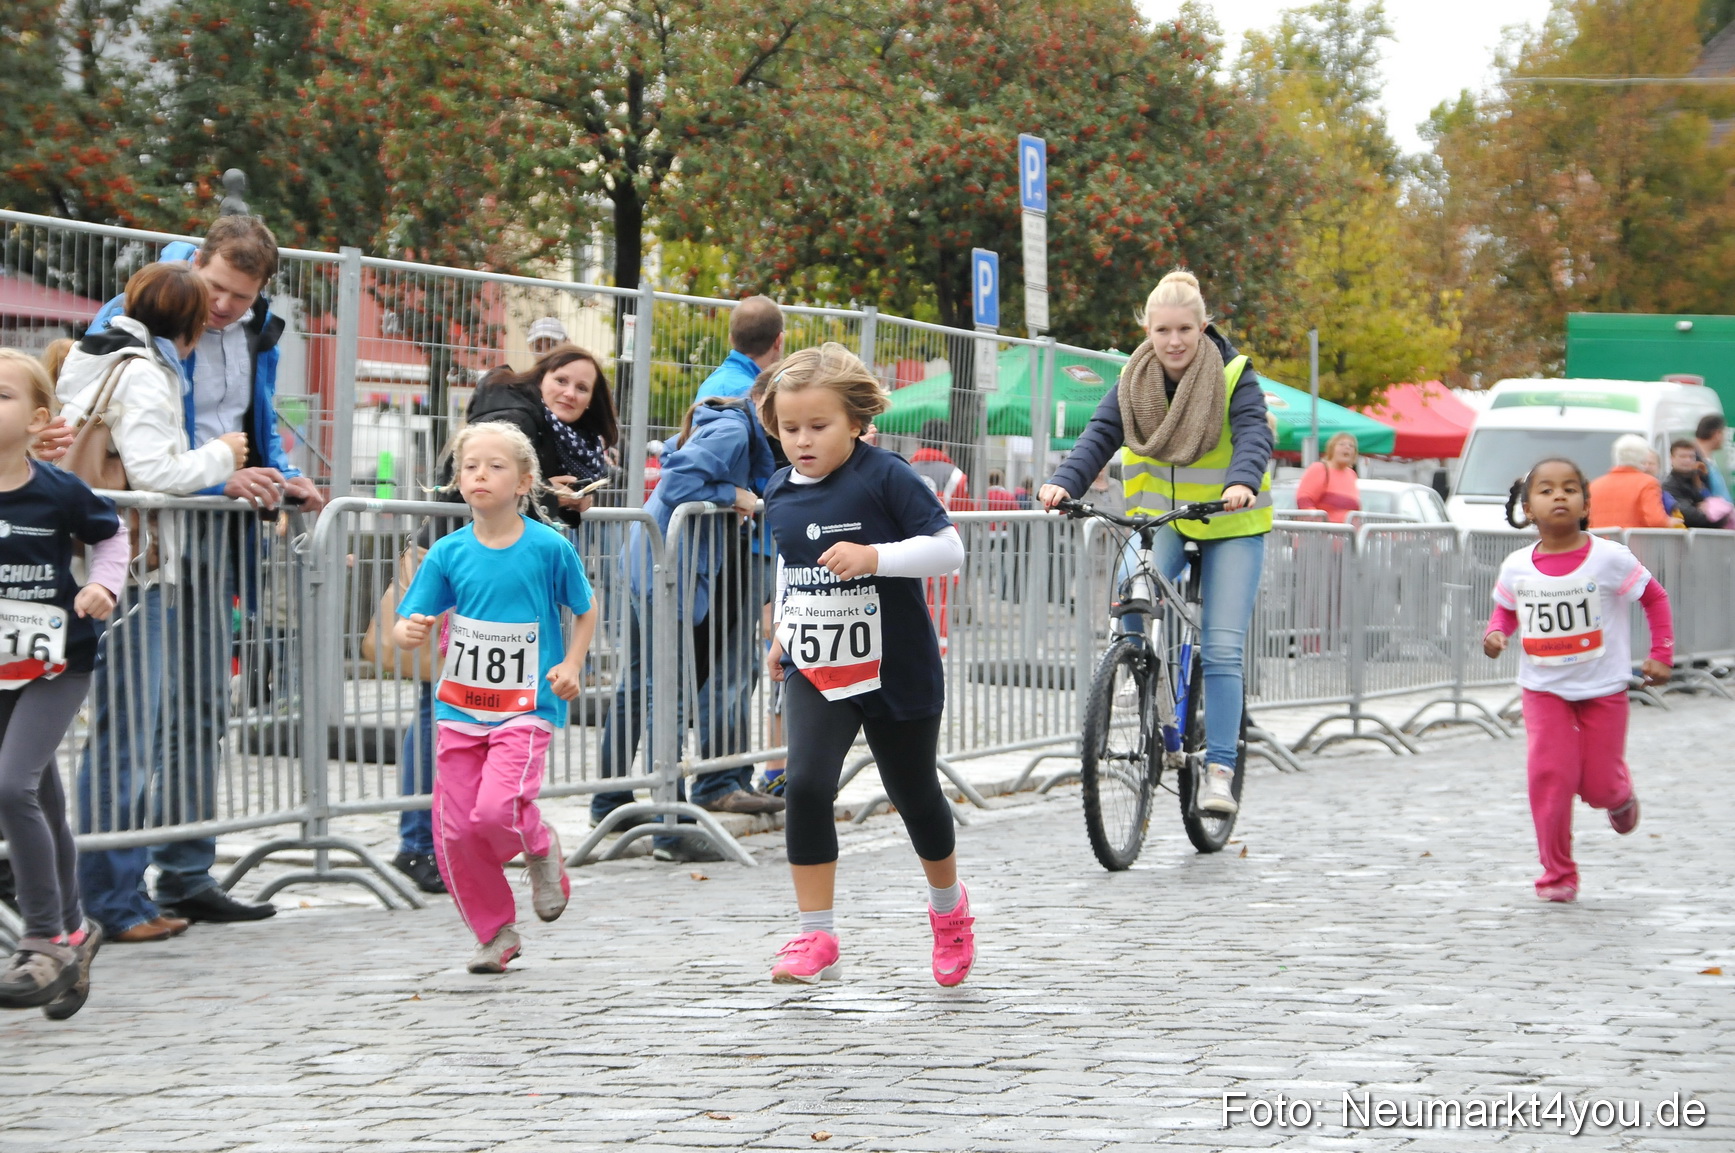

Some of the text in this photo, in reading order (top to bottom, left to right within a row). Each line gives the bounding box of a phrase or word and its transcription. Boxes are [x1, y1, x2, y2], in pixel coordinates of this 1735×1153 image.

[1025, 146, 1041, 199] P
[978, 260, 993, 316] P
[0, 564, 54, 582] CHULE
[1540, 587, 1584, 598] Neumarkt
[0, 613, 43, 625] umarkt
[805, 607, 859, 617] Neumarkt
[1525, 598, 1590, 632] 7501
[0, 626, 50, 662] 16
[472, 630, 521, 642] Neumarkt
[787, 621, 871, 663] 7570
[454, 641, 525, 683] 7181
[465, 691, 500, 708] Heidi
